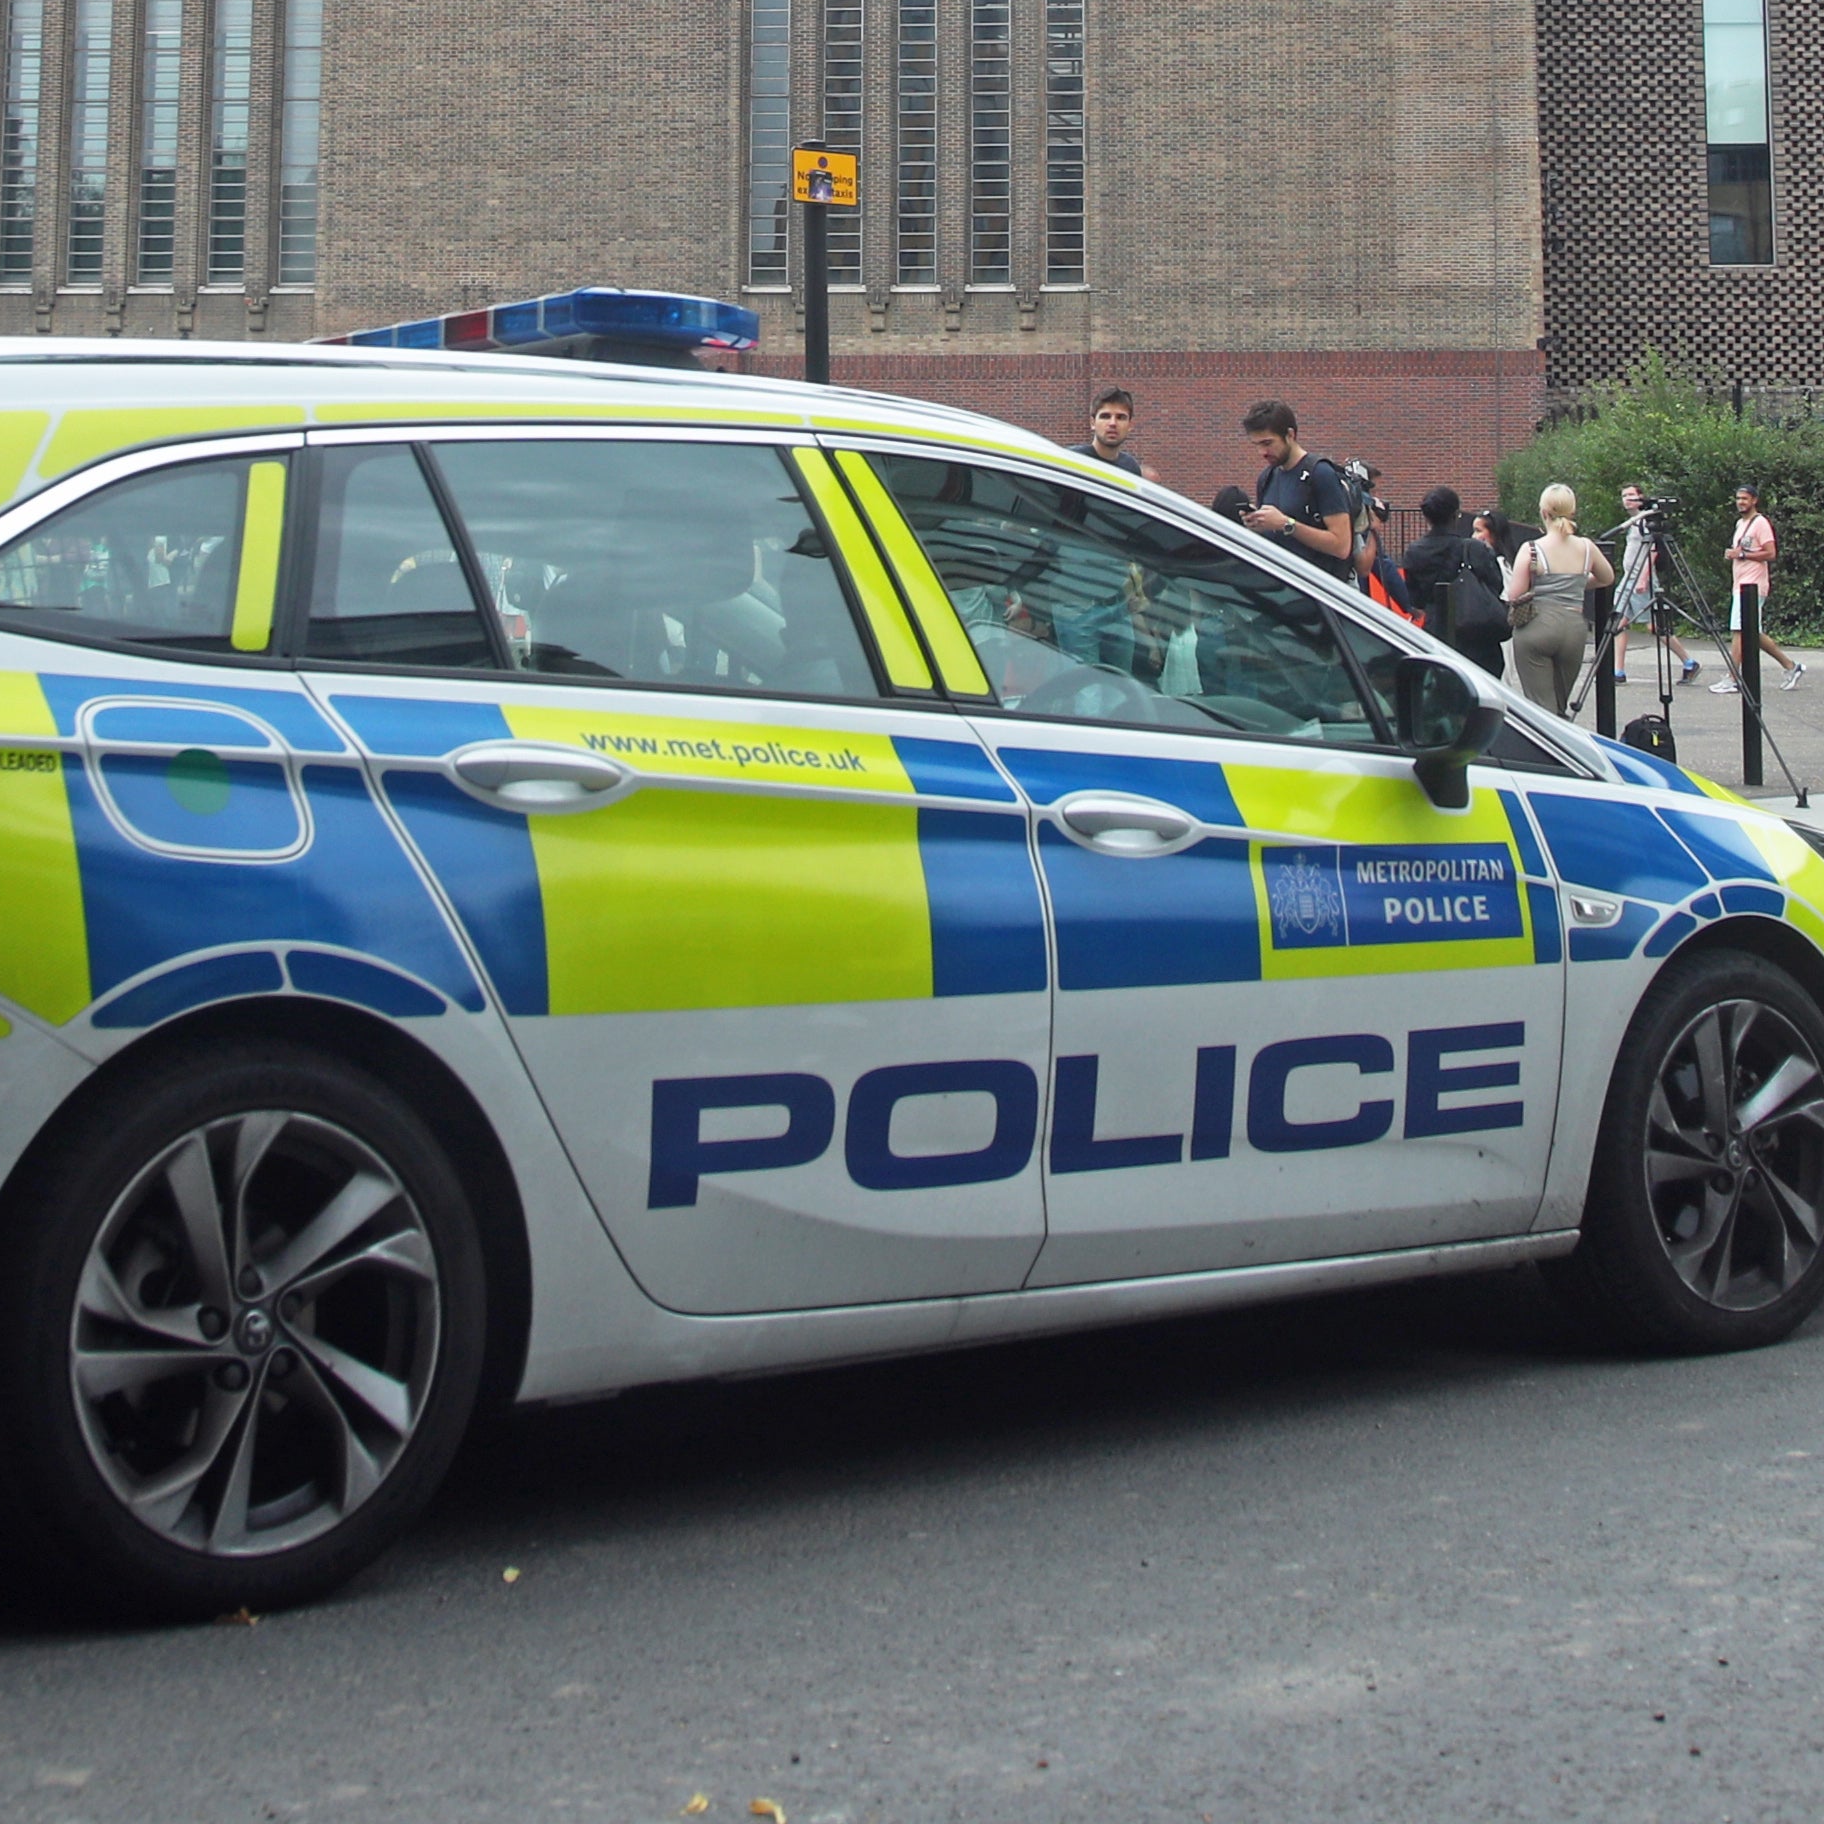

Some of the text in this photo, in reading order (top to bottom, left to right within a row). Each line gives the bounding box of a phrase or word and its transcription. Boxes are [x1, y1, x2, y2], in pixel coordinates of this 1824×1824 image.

[580, 732, 867, 772] www.met.police.uk
[1355, 858, 1505, 884] METROPOLITAN
[1383, 895, 1491, 925] POLICE
[646, 1020, 1526, 1210] POLICE
